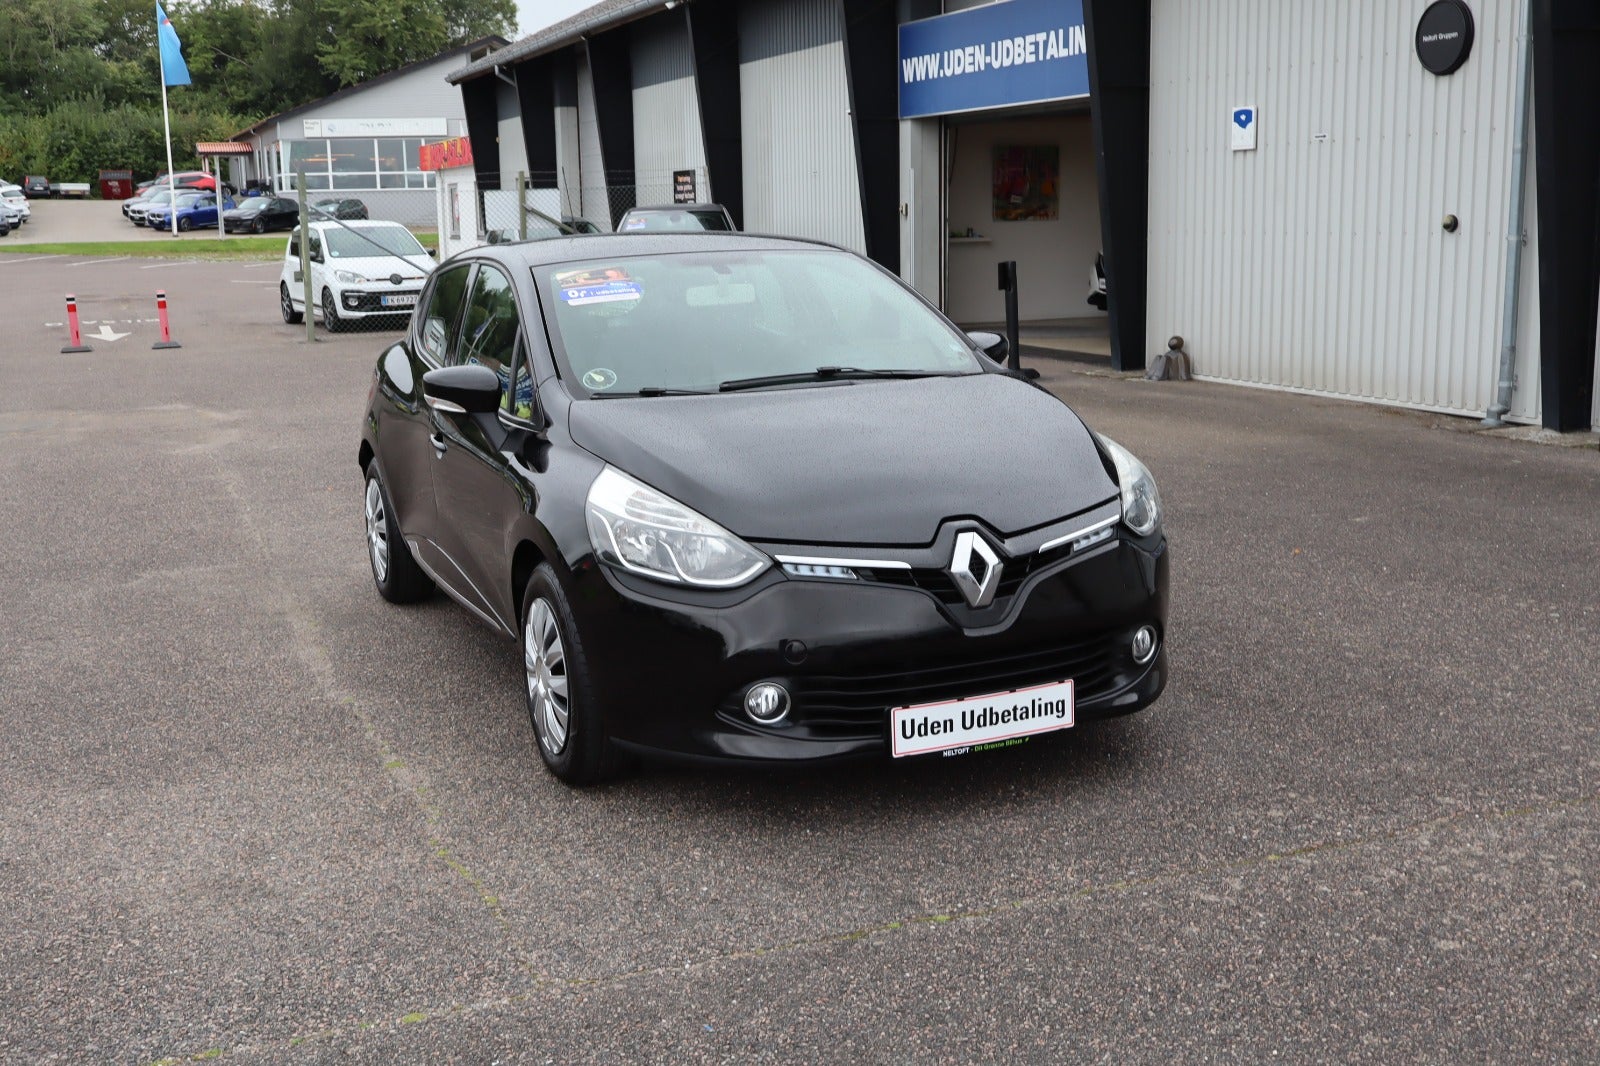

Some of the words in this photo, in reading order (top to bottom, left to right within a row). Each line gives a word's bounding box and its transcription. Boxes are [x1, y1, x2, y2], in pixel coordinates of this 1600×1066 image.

[901, 716, 954, 740] Uden
[961, 698, 1066, 731] Udbetaling
[943, 746, 970, 757] NELTOFT
